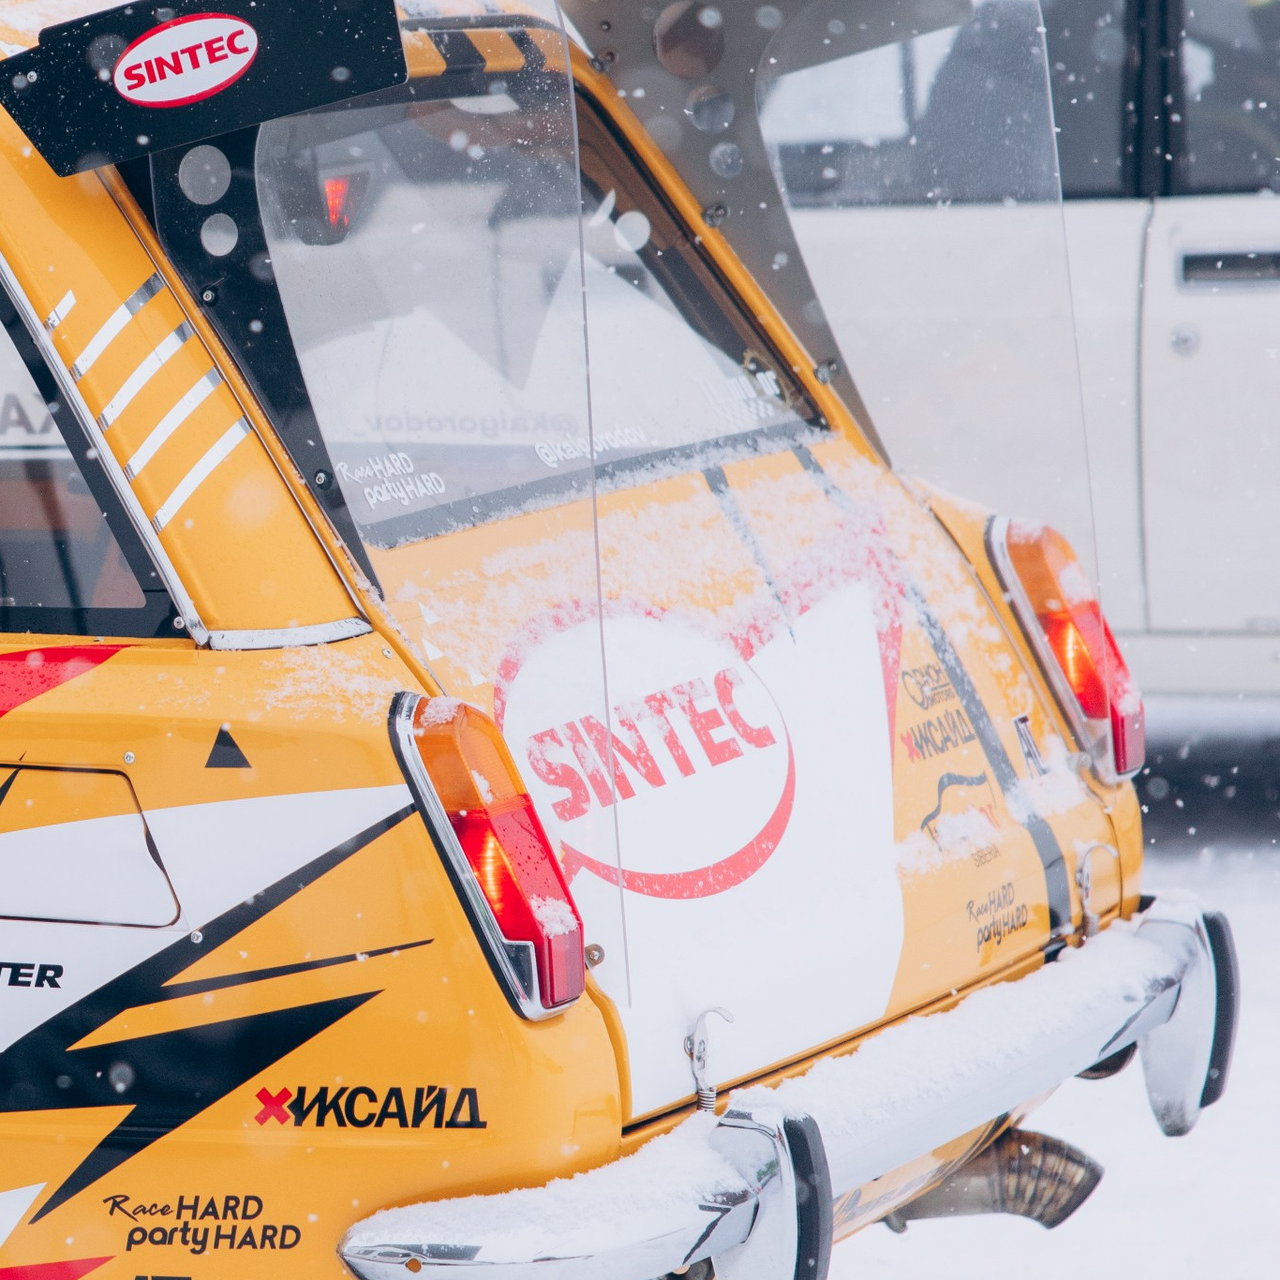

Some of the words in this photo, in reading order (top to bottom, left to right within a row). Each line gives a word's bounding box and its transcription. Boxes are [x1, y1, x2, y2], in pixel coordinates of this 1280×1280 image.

[123, 29, 250, 91] SINTEC
[526, 667, 777, 822] SINTEC
[103, 1194, 174, 1222] Race
[175, 1195, 263, 1221] HARD
[125, 1221, 210, 1255] party
[213, 1224, 302, 1250] HARD
